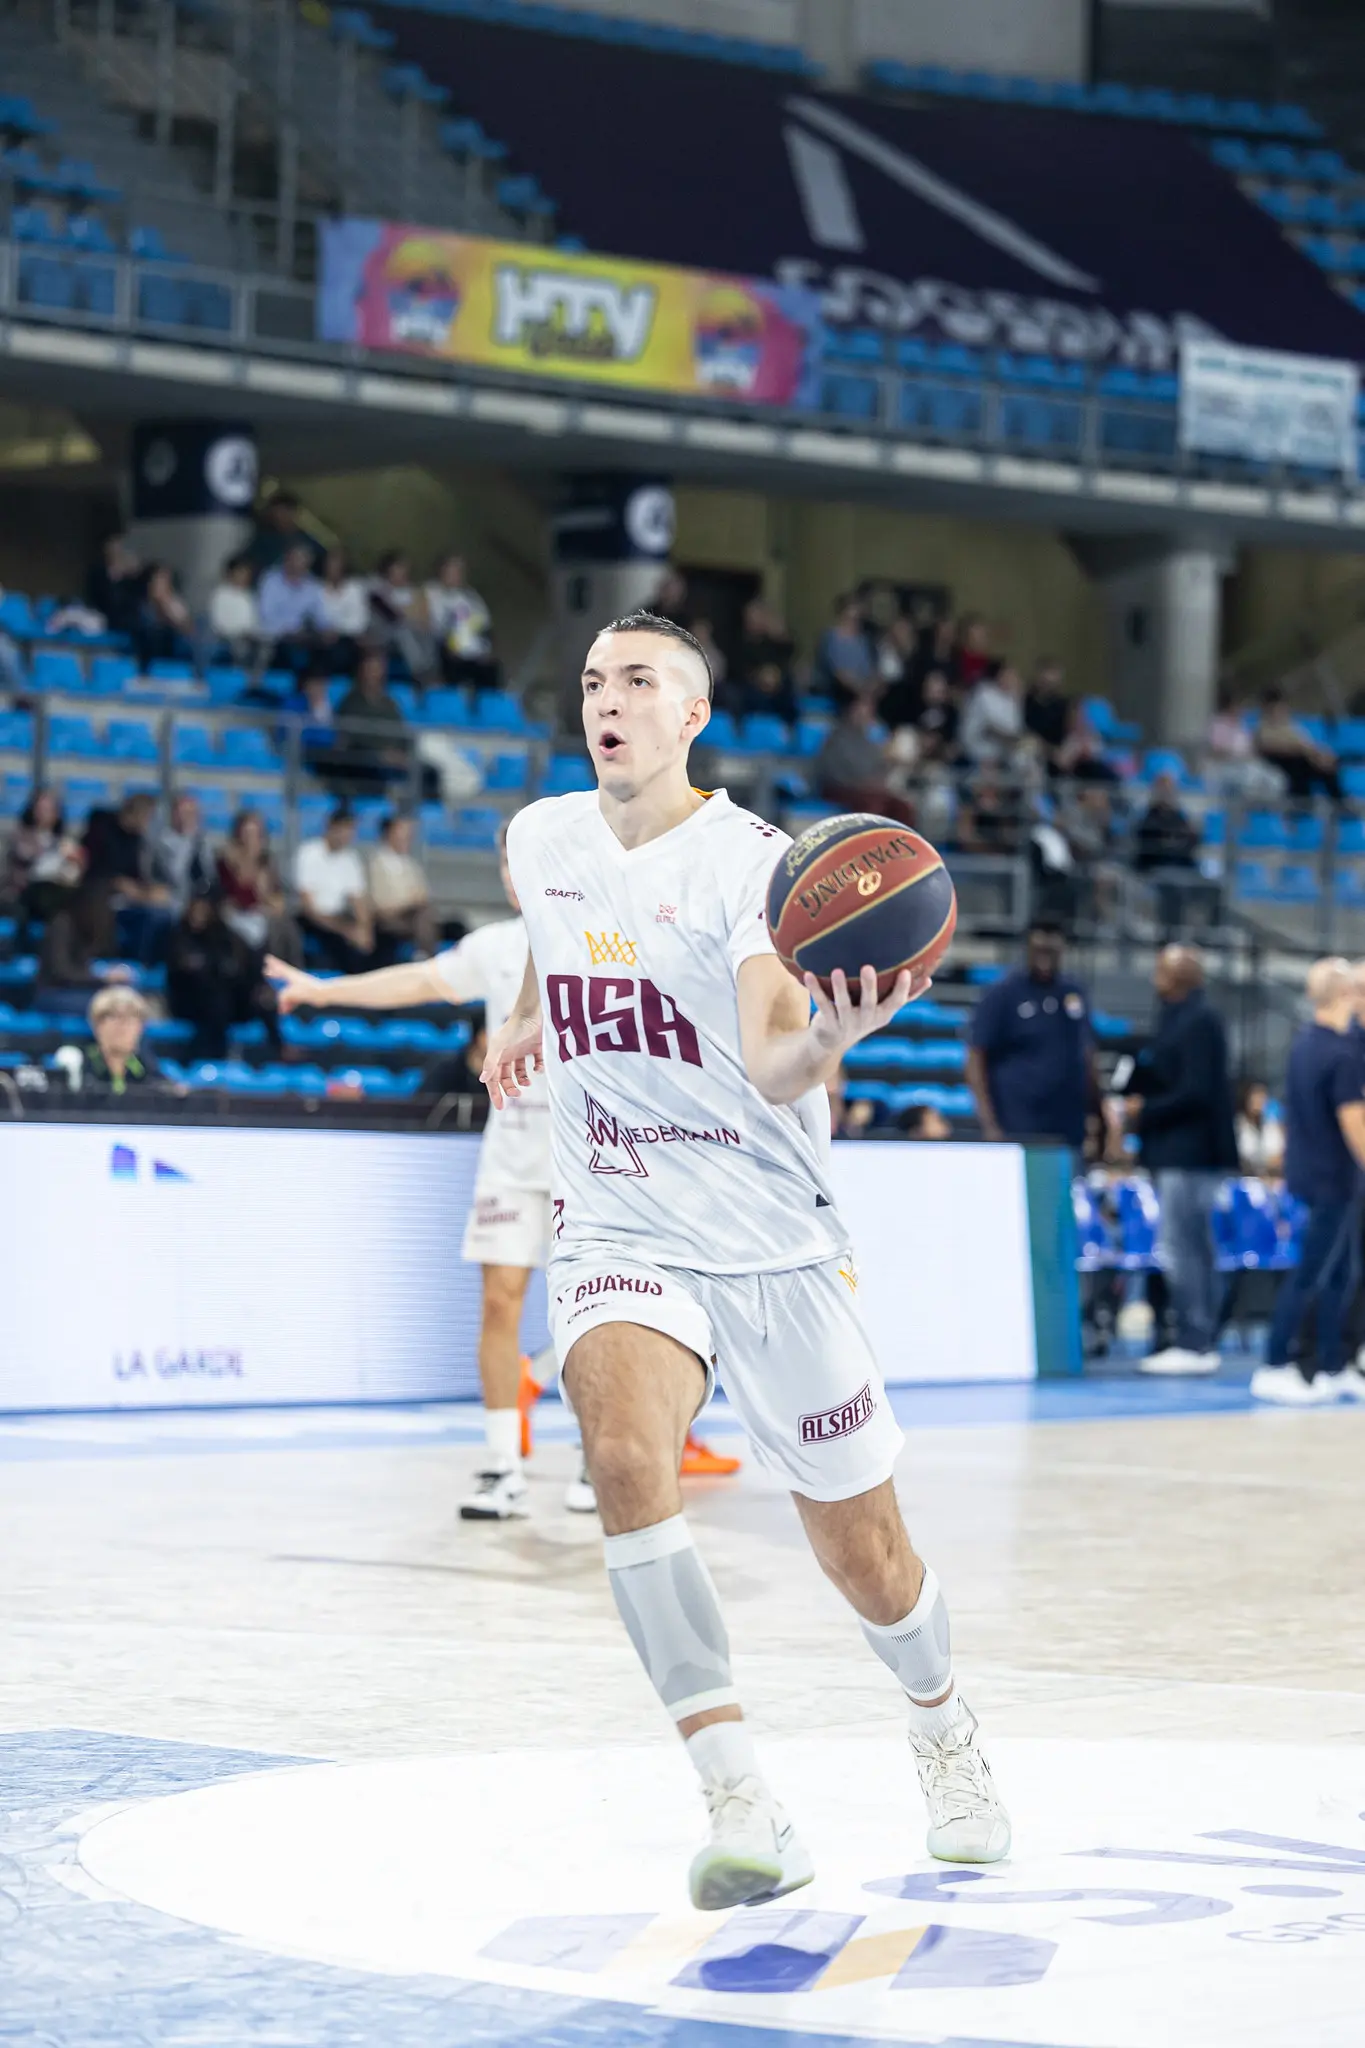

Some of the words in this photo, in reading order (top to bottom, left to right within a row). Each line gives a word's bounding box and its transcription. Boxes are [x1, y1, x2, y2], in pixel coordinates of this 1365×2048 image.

[544, 887, 578, 900] CRAFT
[798, 836, 918, 920] SPALDING
[546, 974, 703, 1069] ASA
